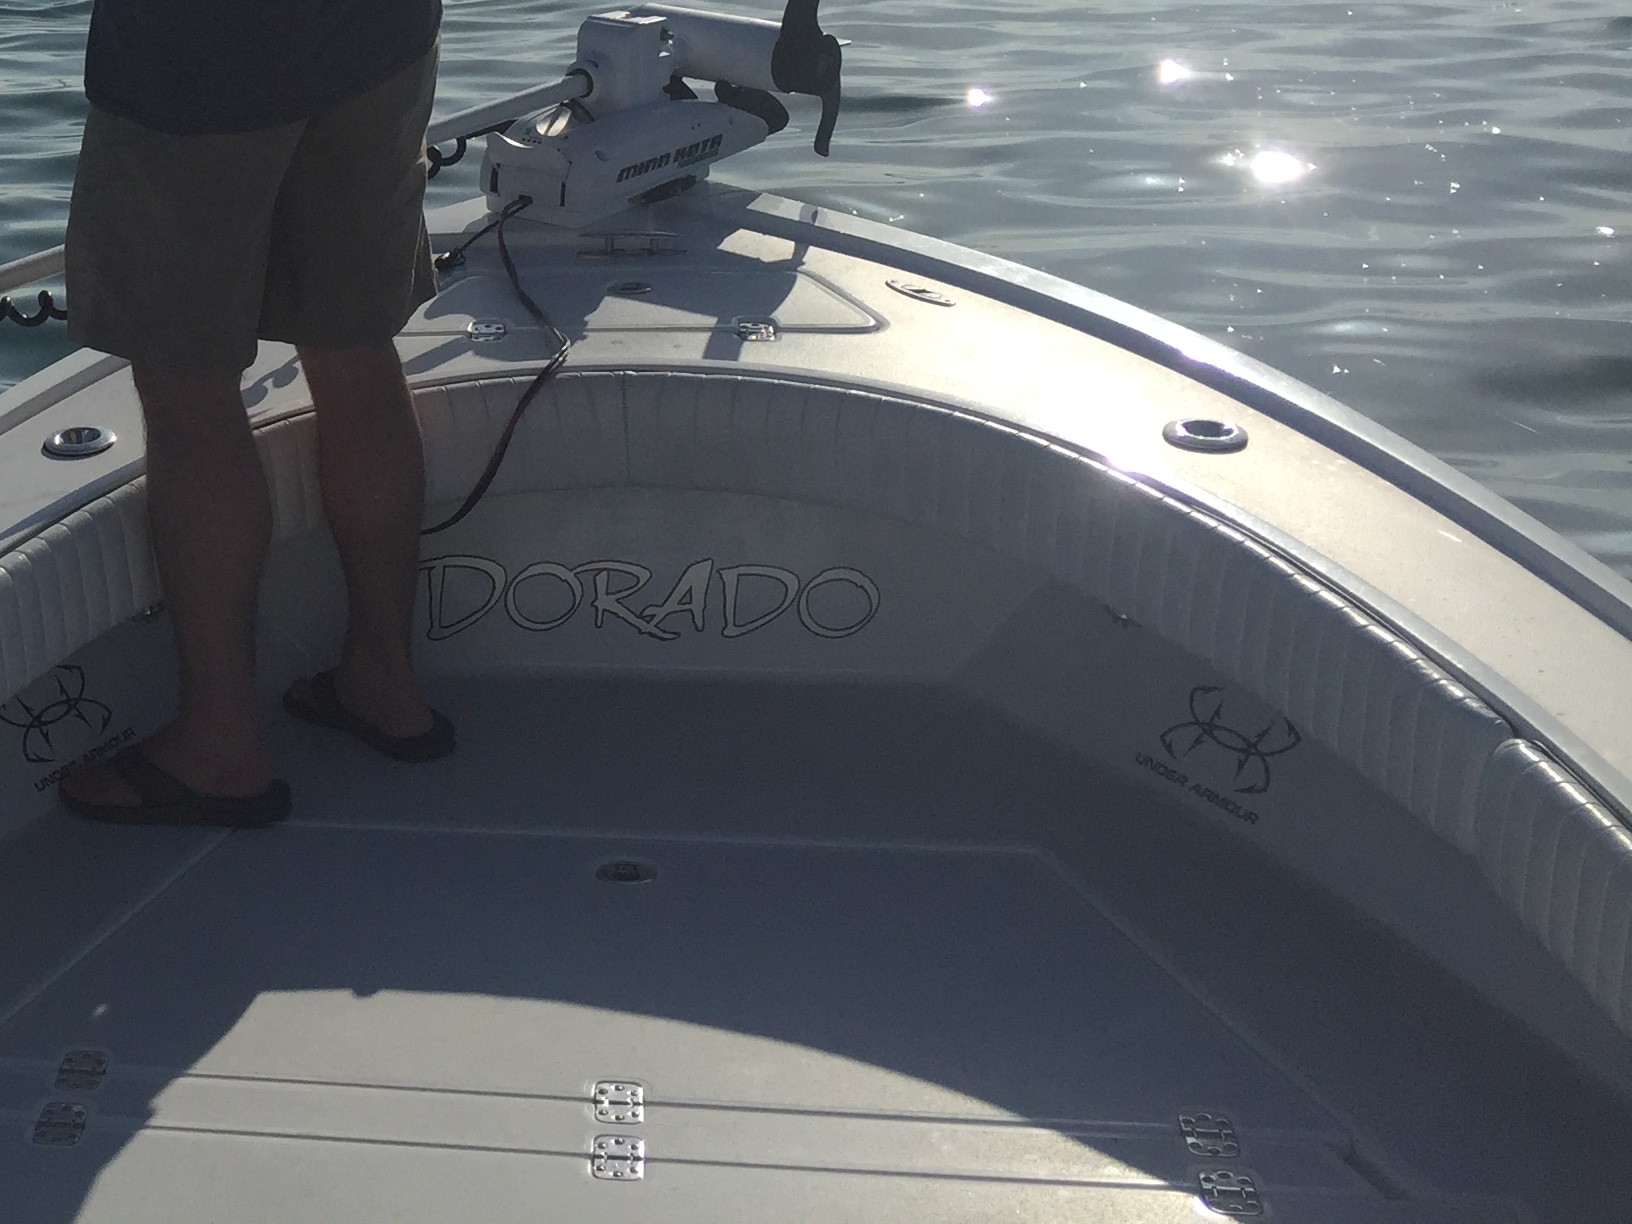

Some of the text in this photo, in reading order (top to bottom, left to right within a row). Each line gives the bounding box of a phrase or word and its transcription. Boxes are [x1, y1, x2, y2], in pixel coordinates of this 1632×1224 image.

[420, 554, 881, 641] DORADO
[1135, 751, 1259, 824] UNDER ARMOUR
